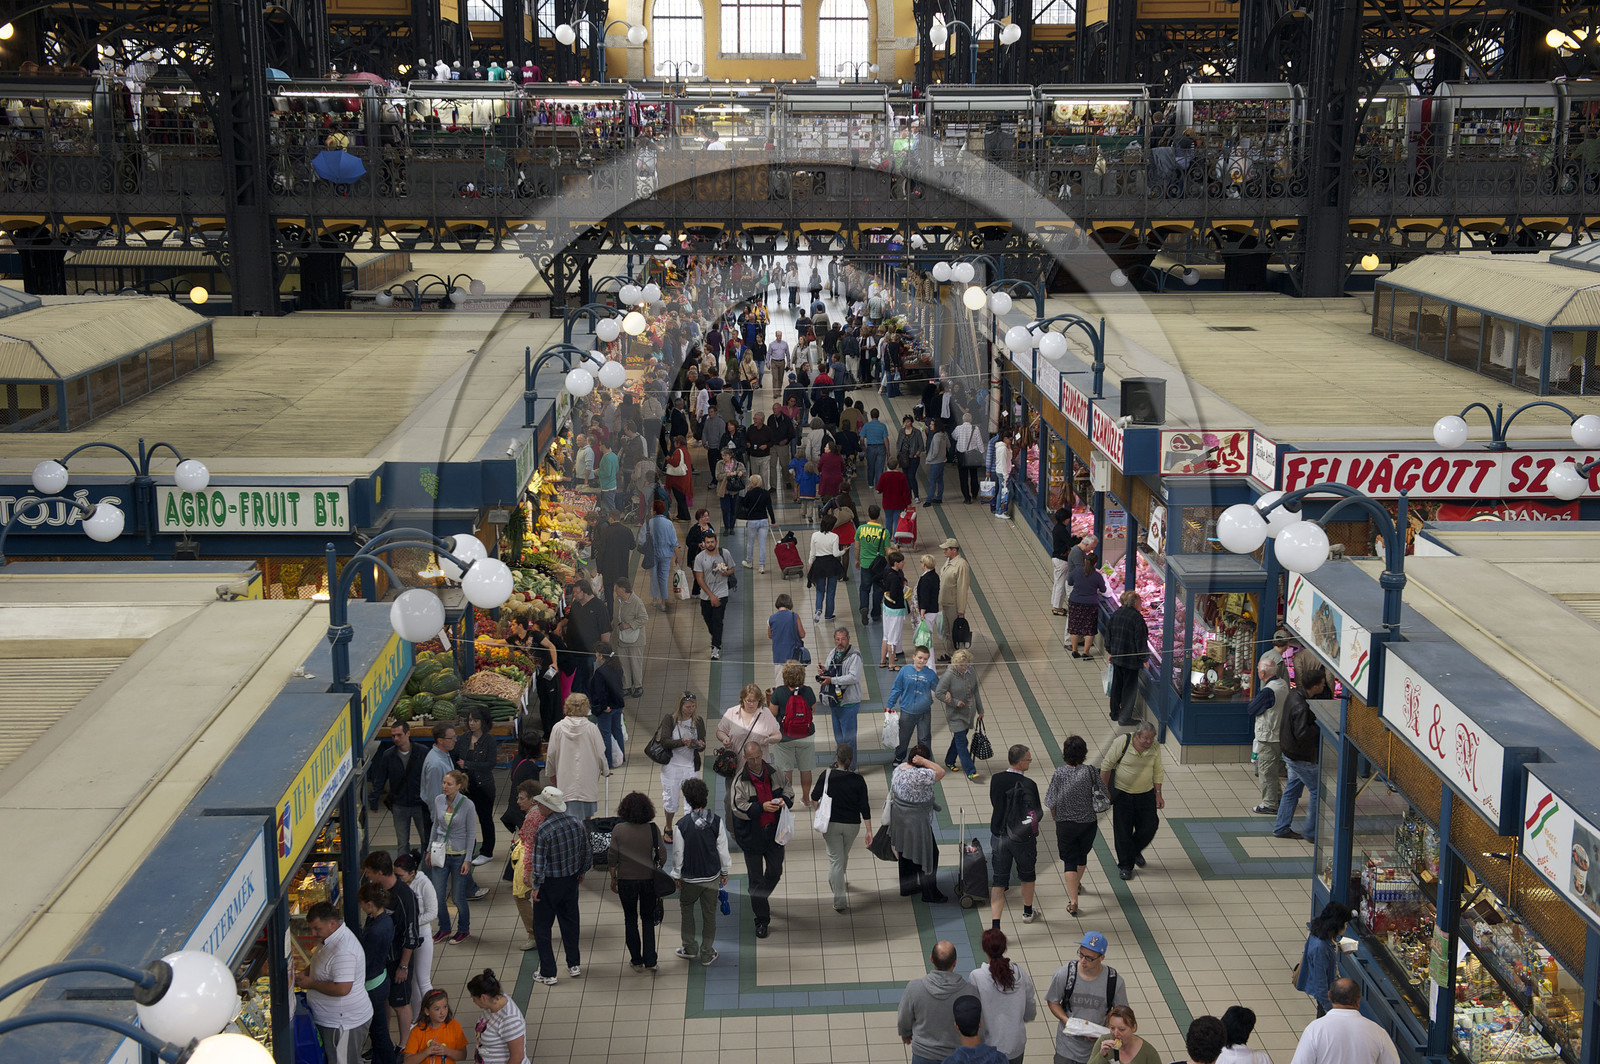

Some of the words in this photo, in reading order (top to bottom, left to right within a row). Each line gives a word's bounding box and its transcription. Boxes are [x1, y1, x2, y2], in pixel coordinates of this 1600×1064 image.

[1286, 454, 1497, 494] FELVÁGOTT
[164, 491, 300, 528] AGRO-FRUIT
[314, 492, 344, 528] BT.
[866, 535, 878, 544] 07
[1429, 704, 1446, 759] &
